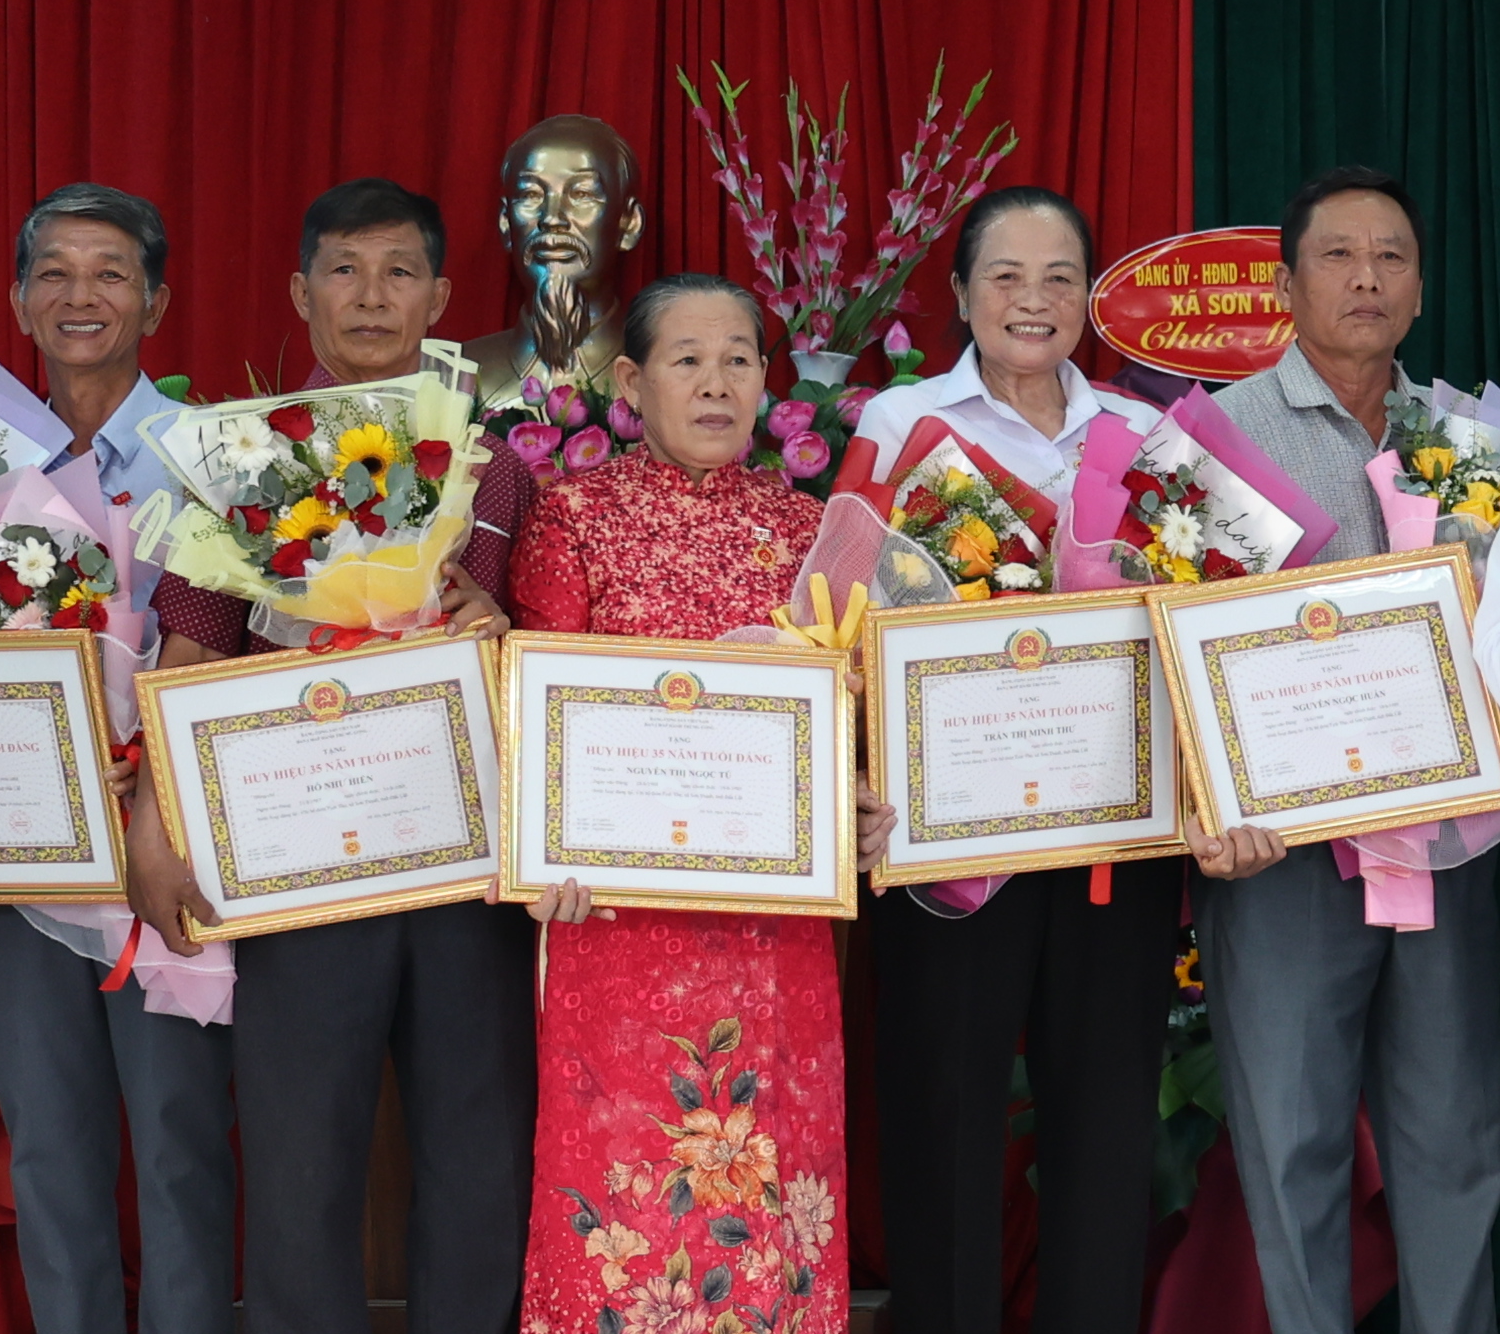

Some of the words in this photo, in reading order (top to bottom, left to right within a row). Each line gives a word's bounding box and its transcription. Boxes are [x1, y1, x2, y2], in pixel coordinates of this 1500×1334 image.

[1173, 257, 1191, 286] ỦY
[1202, 263, 1238, 286] HĐND
[1250, 261, 1281, 284] UBN
[1170, 288, 1201, 317] XÃ
[1208, 292, 1252, 316] SƠN
[1140, 320, 1235, 351] Chúc
